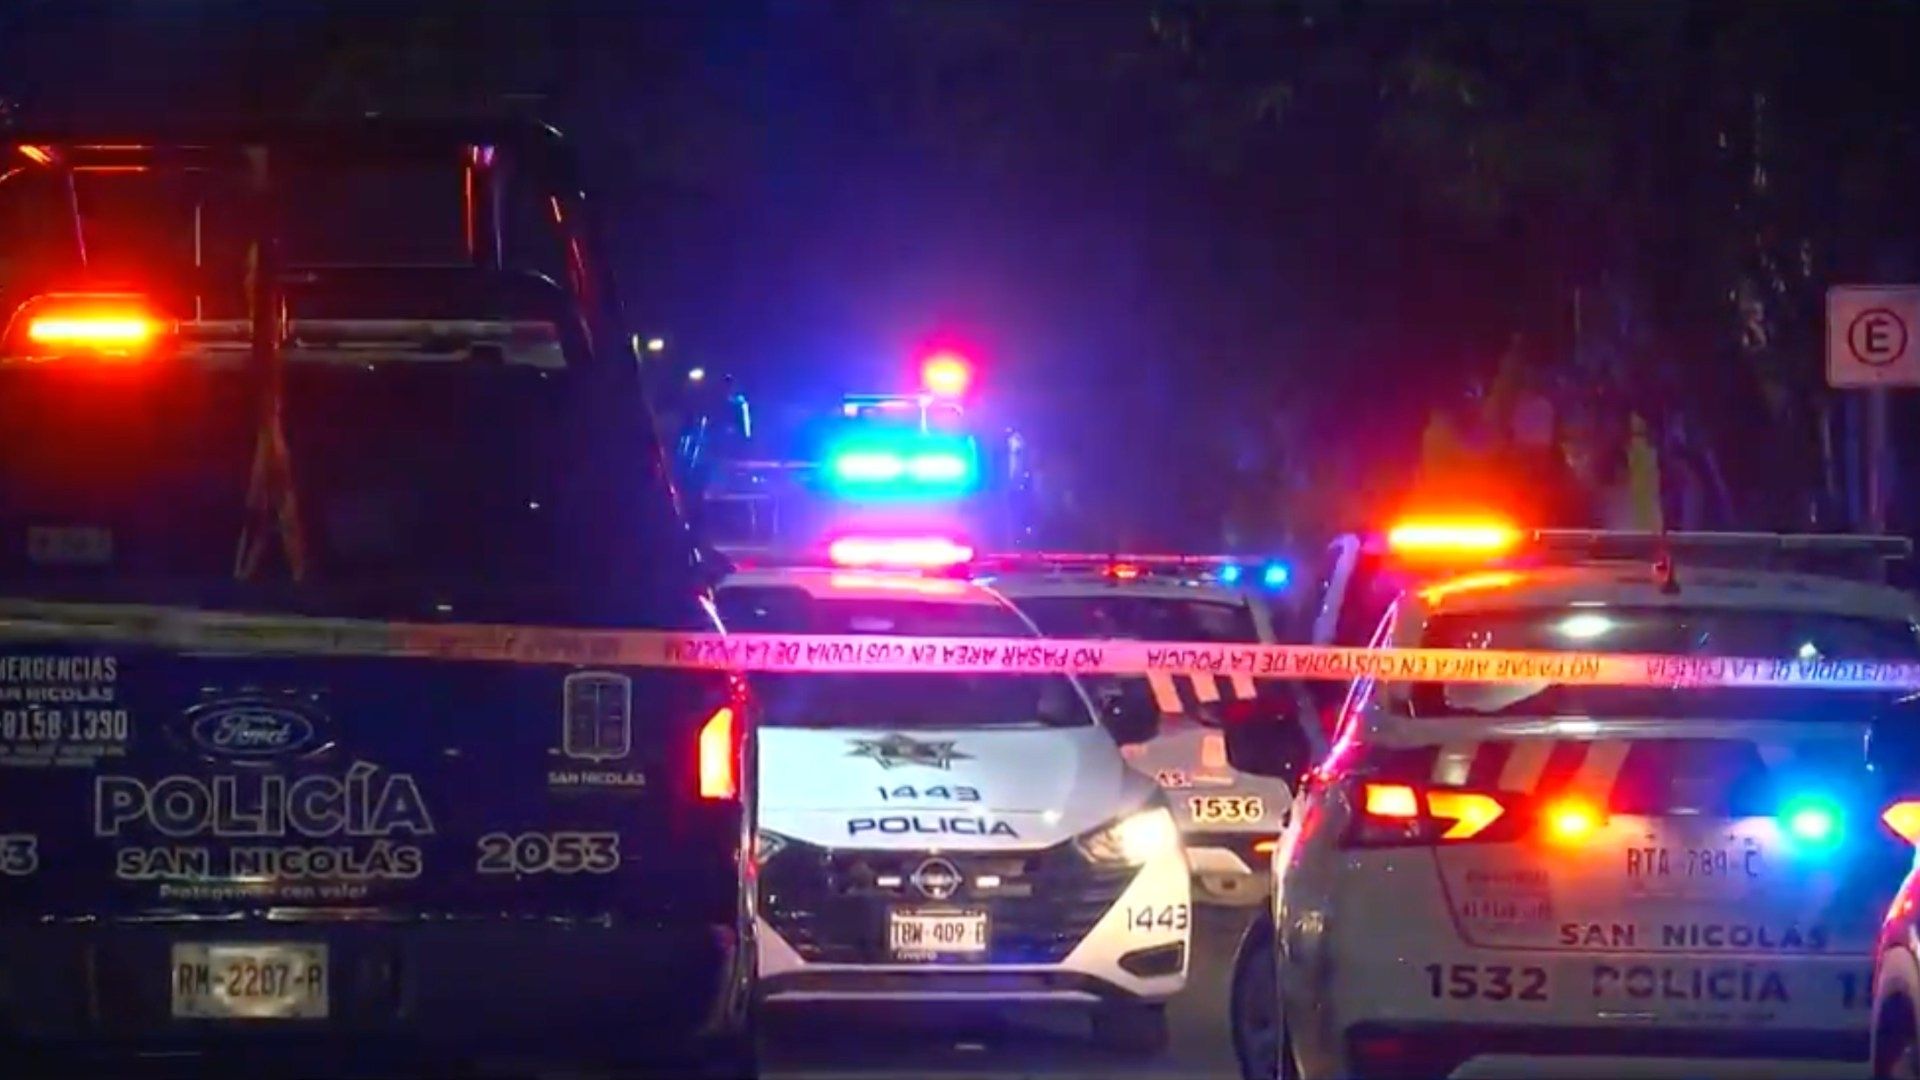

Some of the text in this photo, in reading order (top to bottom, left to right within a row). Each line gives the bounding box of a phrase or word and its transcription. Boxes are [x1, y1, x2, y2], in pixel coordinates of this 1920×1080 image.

[1865, 319, 1890, 353] E
[745, 641, 770, 664] LA
[776, 643, 801, 665] DE
[911, 644, 937, 664] EN
[942, 645, 997, 666] AREA
[1001, 646, 1069, 667] PASAR
[1072, 649, 1104, 667] NO
[1147, 650, 1225, 672] POLICIA
[1231, 651, 1257, 672] LA
[1260, 653, 1289, 673] DE
[1571, 658, 1601, 677] NO
[213, 713, 292, 745] Ford
[94, 761, 436, 837] POLICÍA
[877, 785, 982, 802] 1443
[1190, 796, 1262, 821] 1536
[115, 839, 424, 882] SAN NICOLÁS
[476, 831, 620, 875] 2053
[1127, 903, 1188, 932] 1443
[1559, 922, 1635, 947] SAN
[1424, 963, 1549, 1001] 1532
